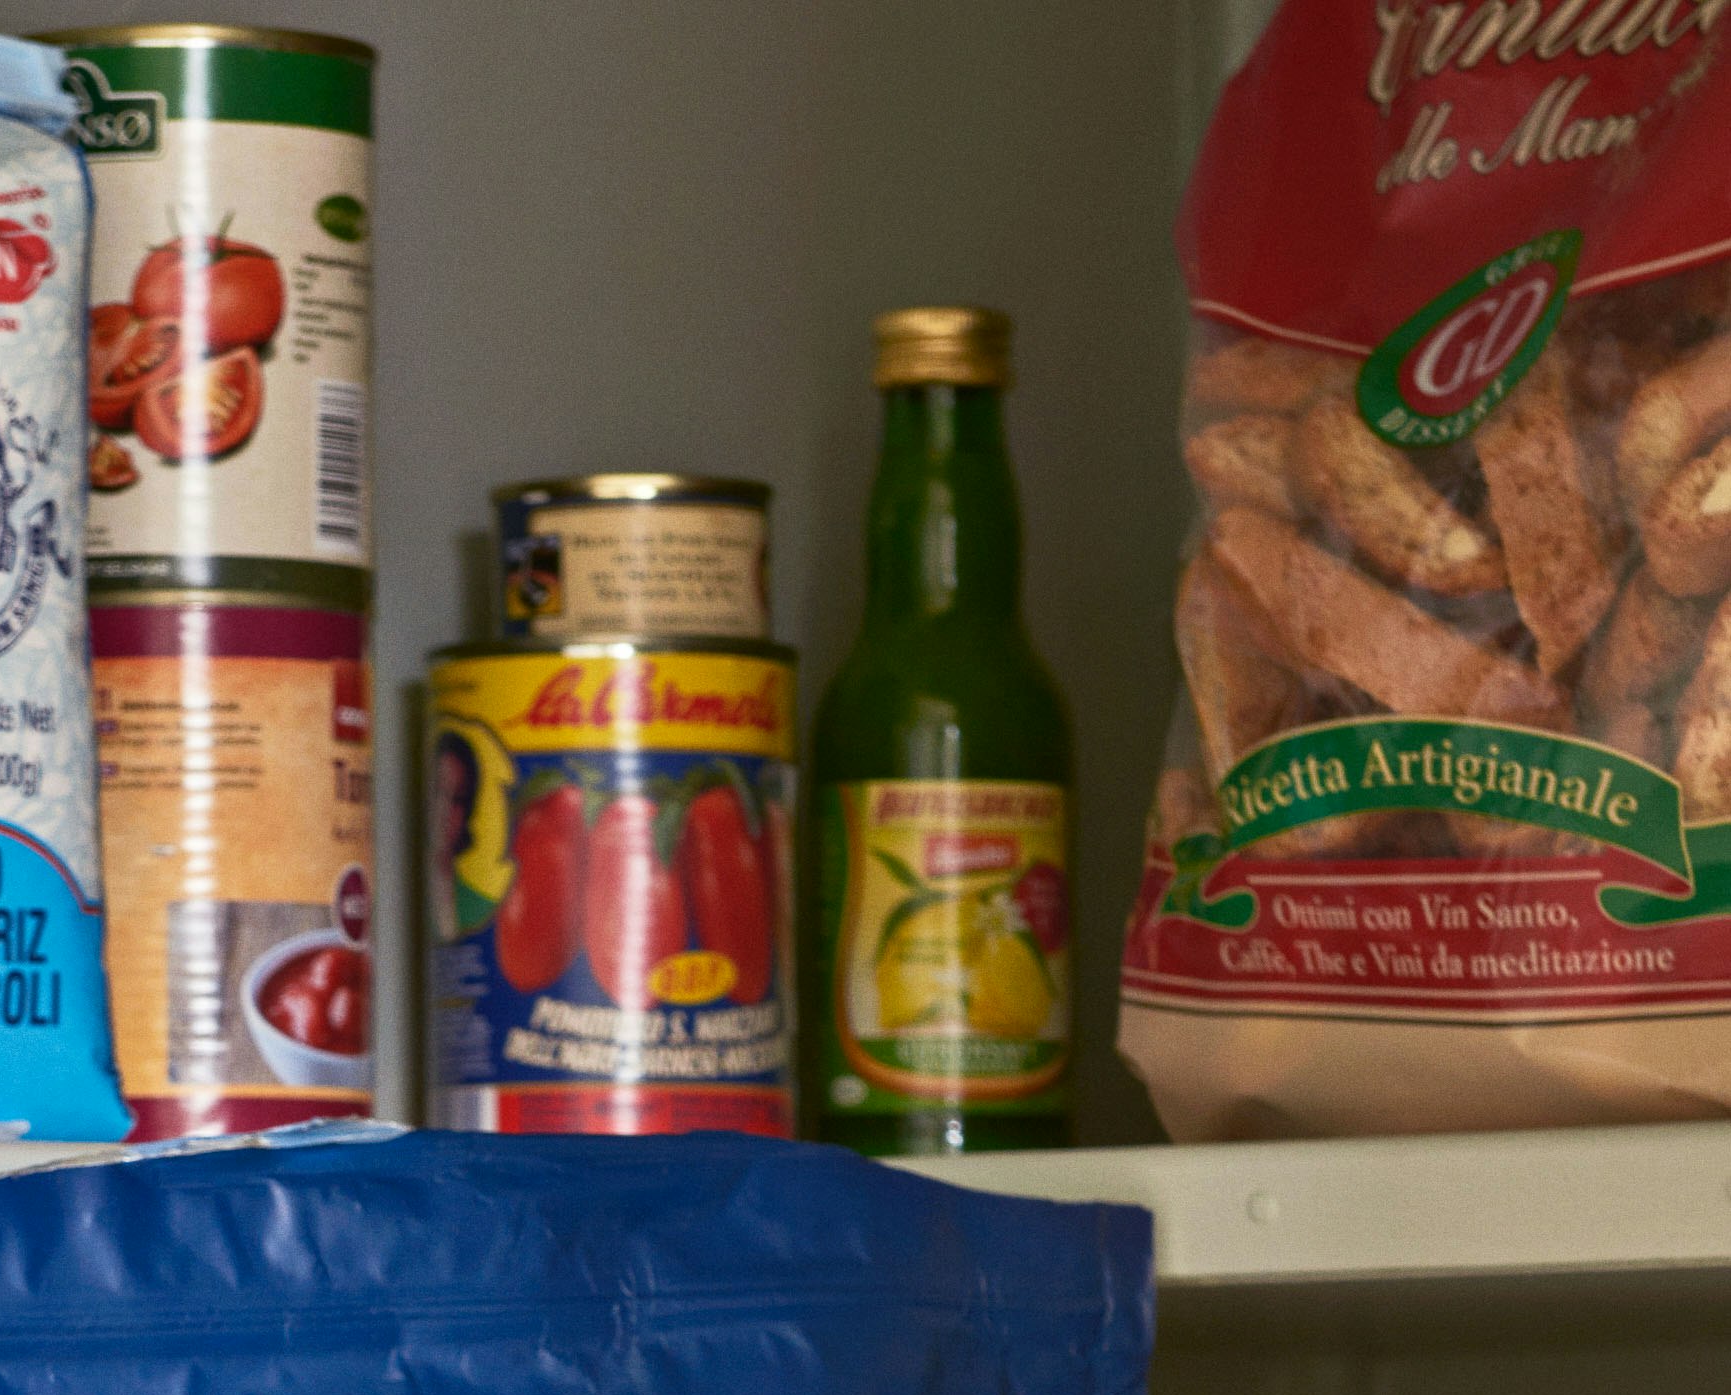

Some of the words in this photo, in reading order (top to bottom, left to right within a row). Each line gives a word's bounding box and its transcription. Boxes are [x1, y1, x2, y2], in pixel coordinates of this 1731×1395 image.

[1222, 755, 1352, 826] Ricetta
[1361, 739, 1639, 827] Artigianale
[1272, 895, 1357, 930] Ottimi
[1363, 905, 1411, 930] con
[1420, 893, 1468, 929] Vin
[1476, 893, 1580, 932] Santo,
[1351, 954, 1368, 976] e
[1369, 942, 1424, 977] Vini
[1430, 942, 1464, 978] da
[1470, 938, 1675, 978] meditazione
